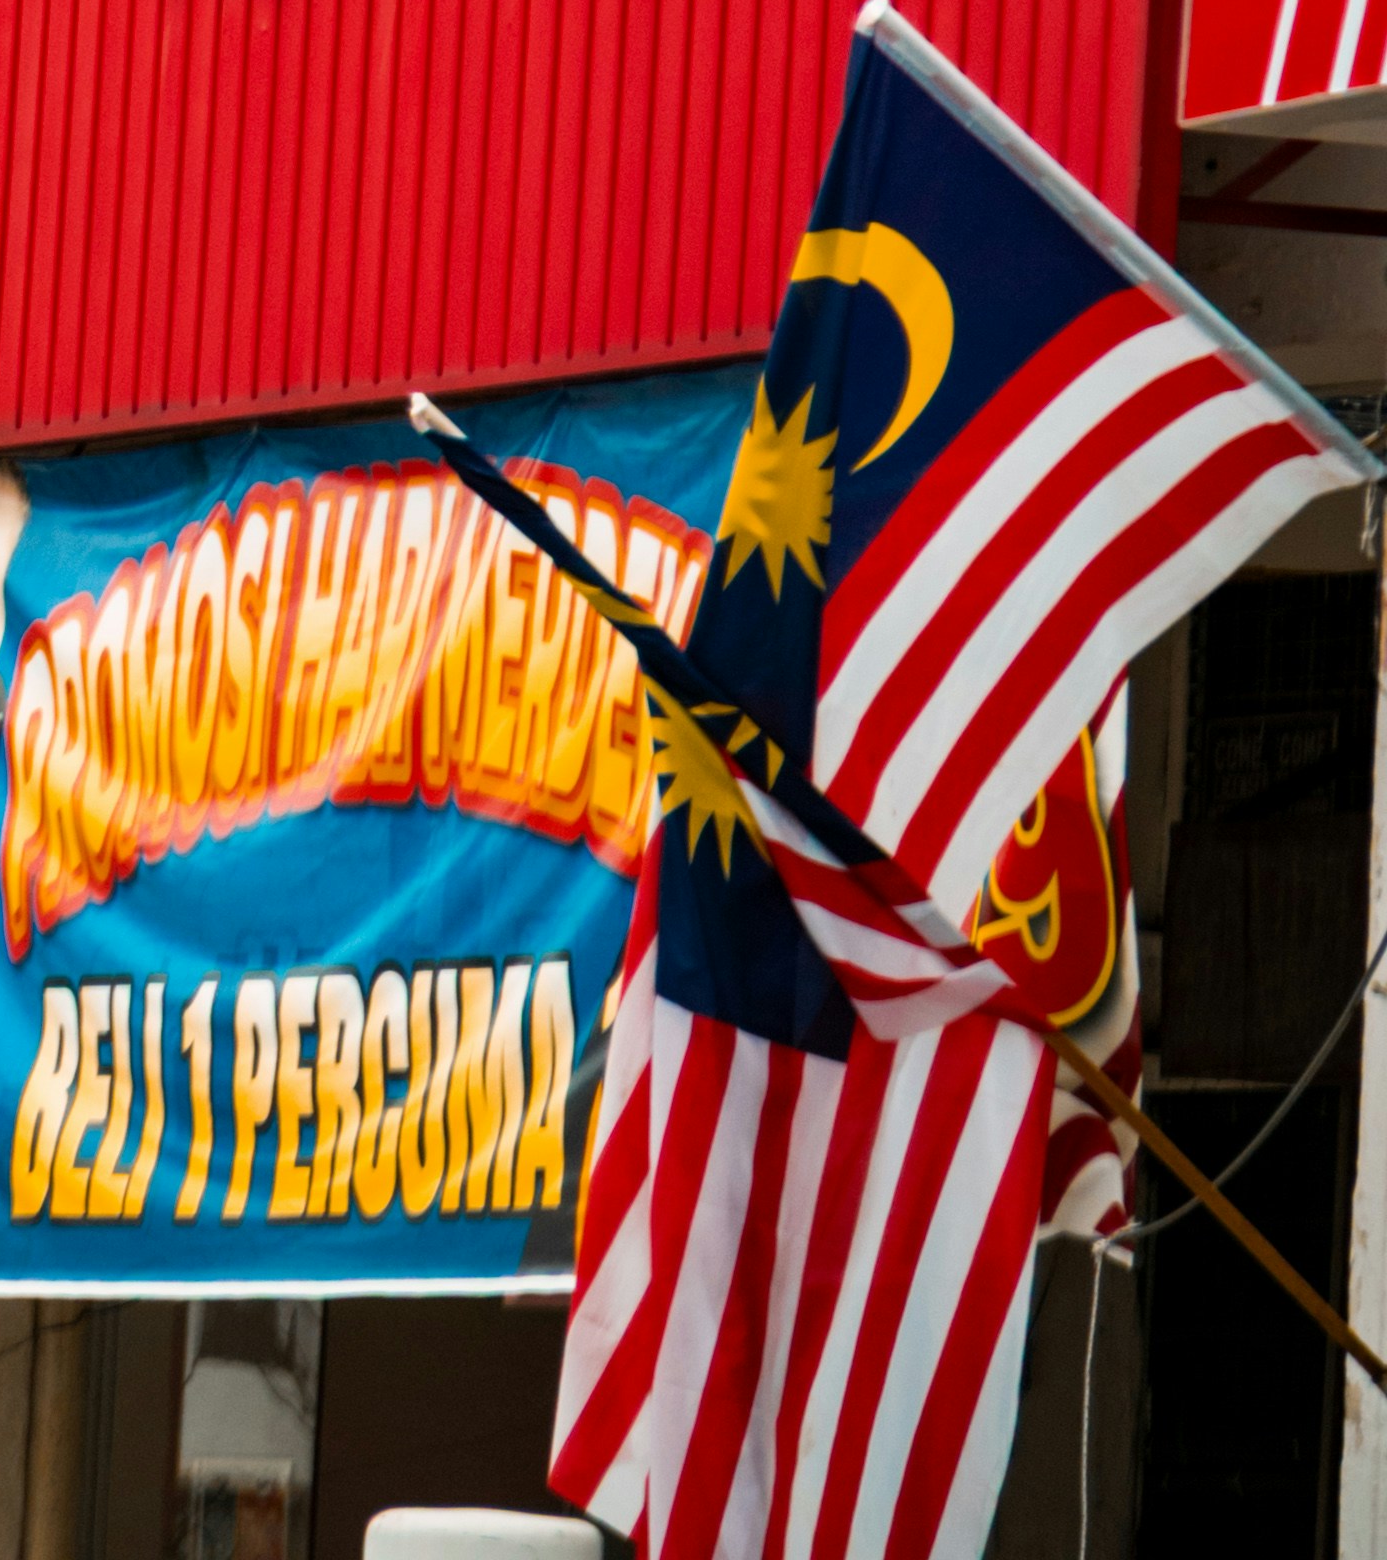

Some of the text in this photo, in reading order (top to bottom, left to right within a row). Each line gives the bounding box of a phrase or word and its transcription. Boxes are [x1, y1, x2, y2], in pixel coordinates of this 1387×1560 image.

[1, 478, 305, 964] PROMOSI
[10, 971, 166, 1224] BELI
[174, 971, 223, 1221] 1
[222, 952, 575, 1224] PERCUMA
